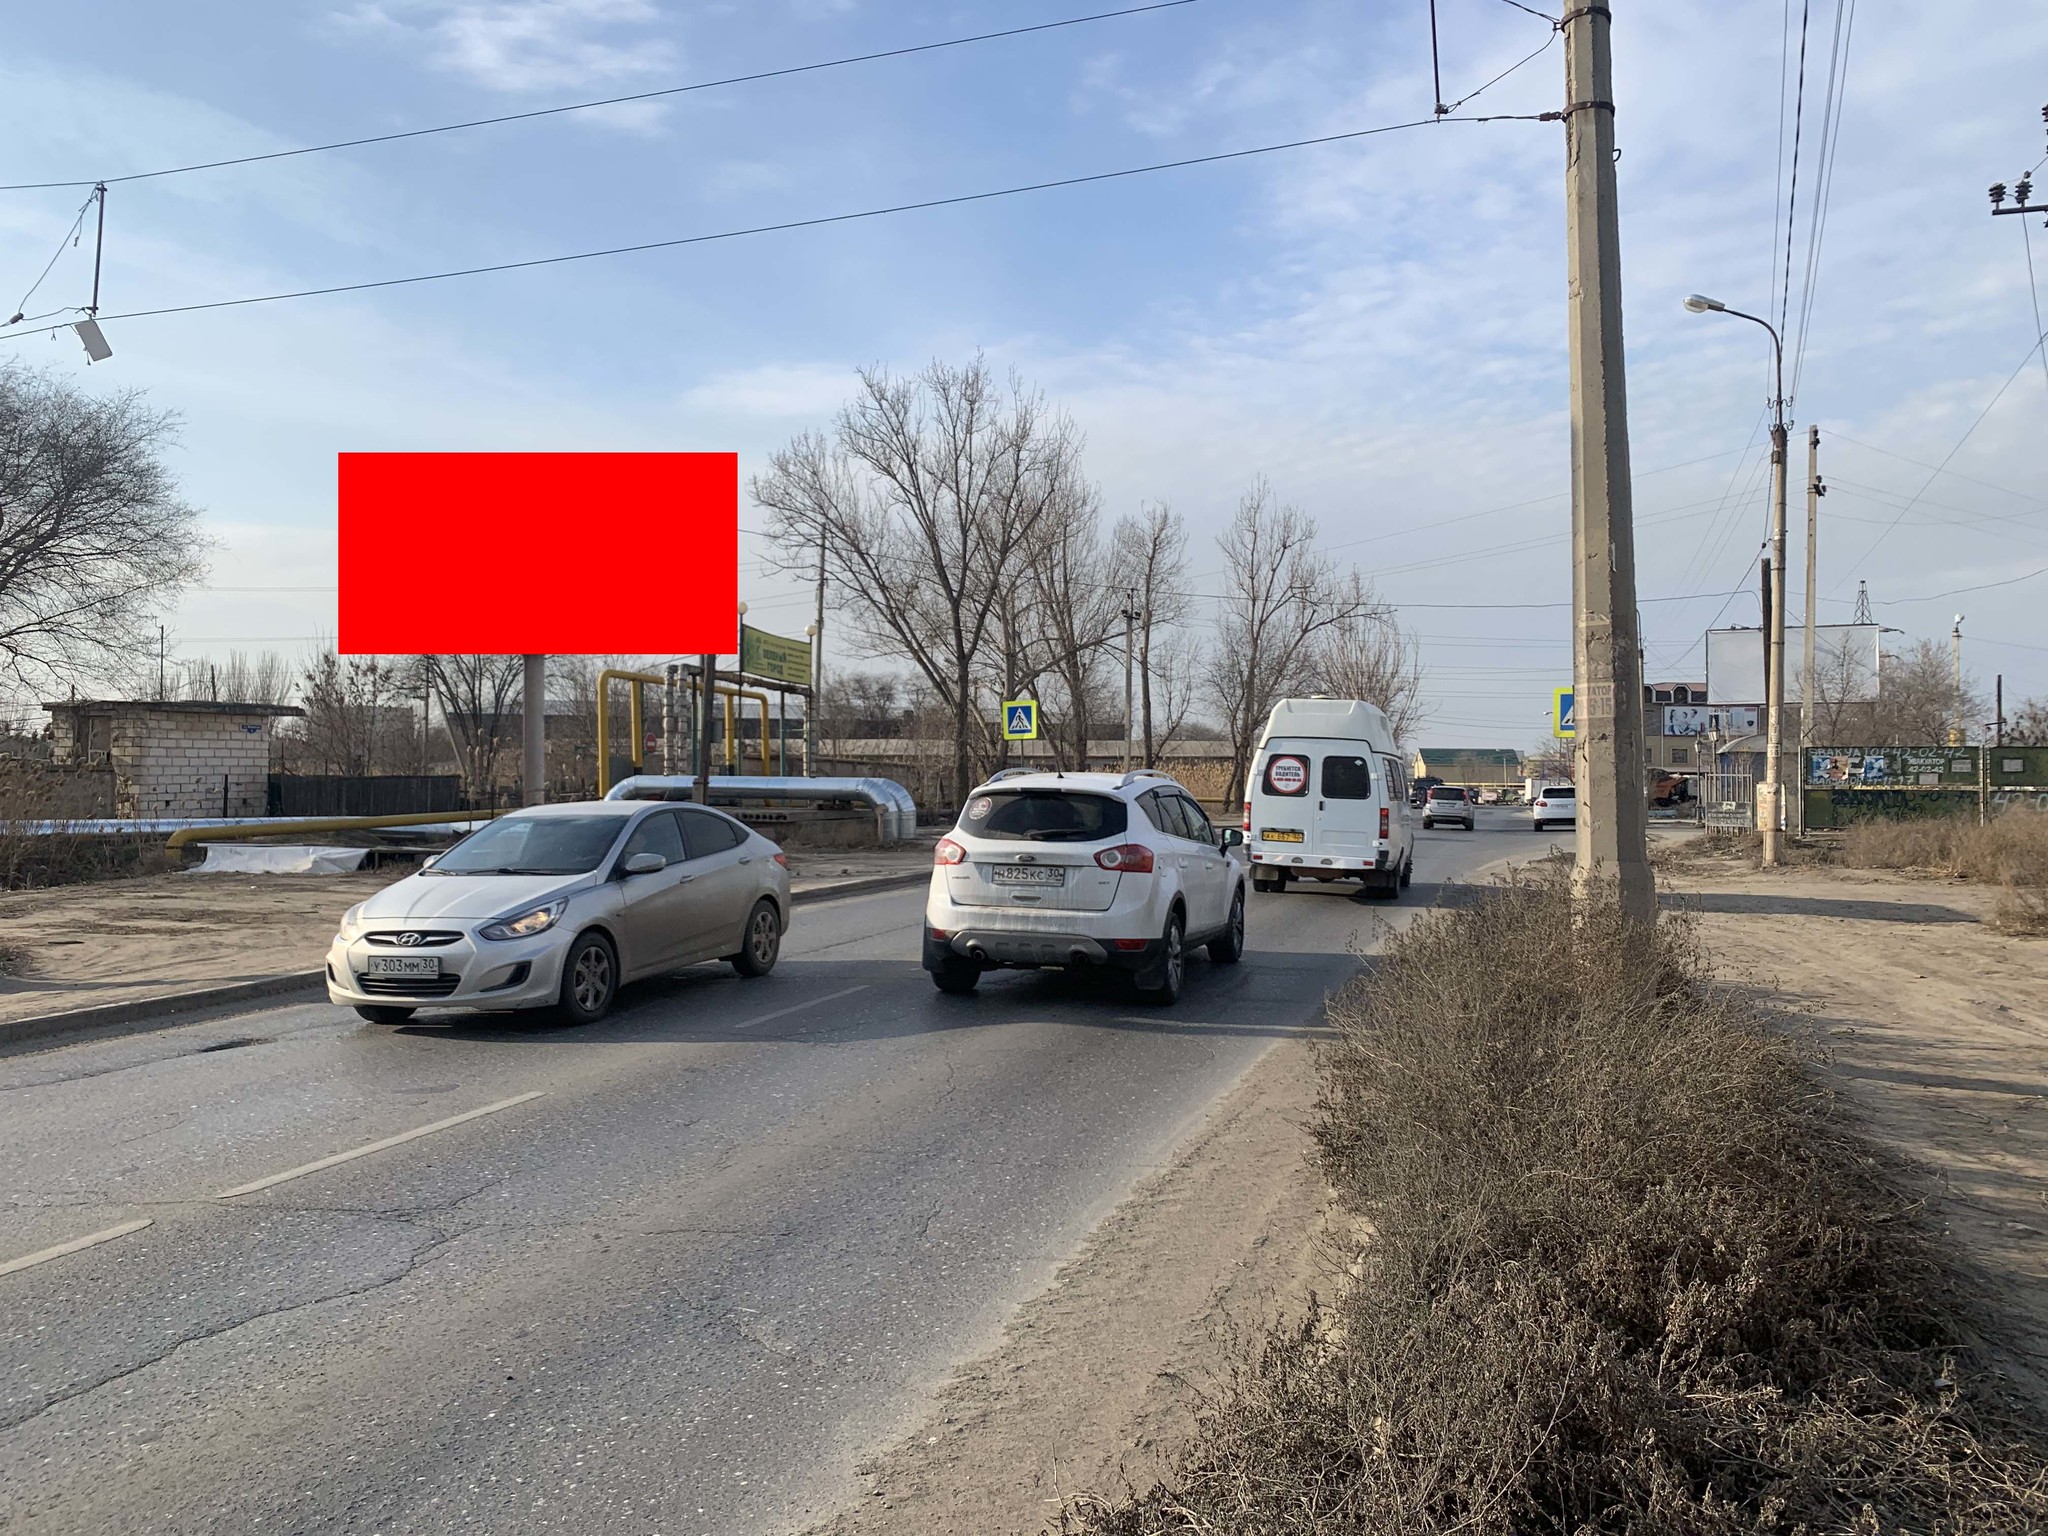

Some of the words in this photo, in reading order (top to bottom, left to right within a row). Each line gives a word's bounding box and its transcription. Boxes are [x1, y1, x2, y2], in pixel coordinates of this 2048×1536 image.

[1808, 747, 1890, 758] ЭВАКУАТОР
[1892, 747, 1969, 760] 42-02-42
[1908, 765, 1945, 773] 42-02-42
[1047, 868, 1060, 878] 30
[373, 959, 420, 972] У303ММ
[422, 959, 434, 969] 30
